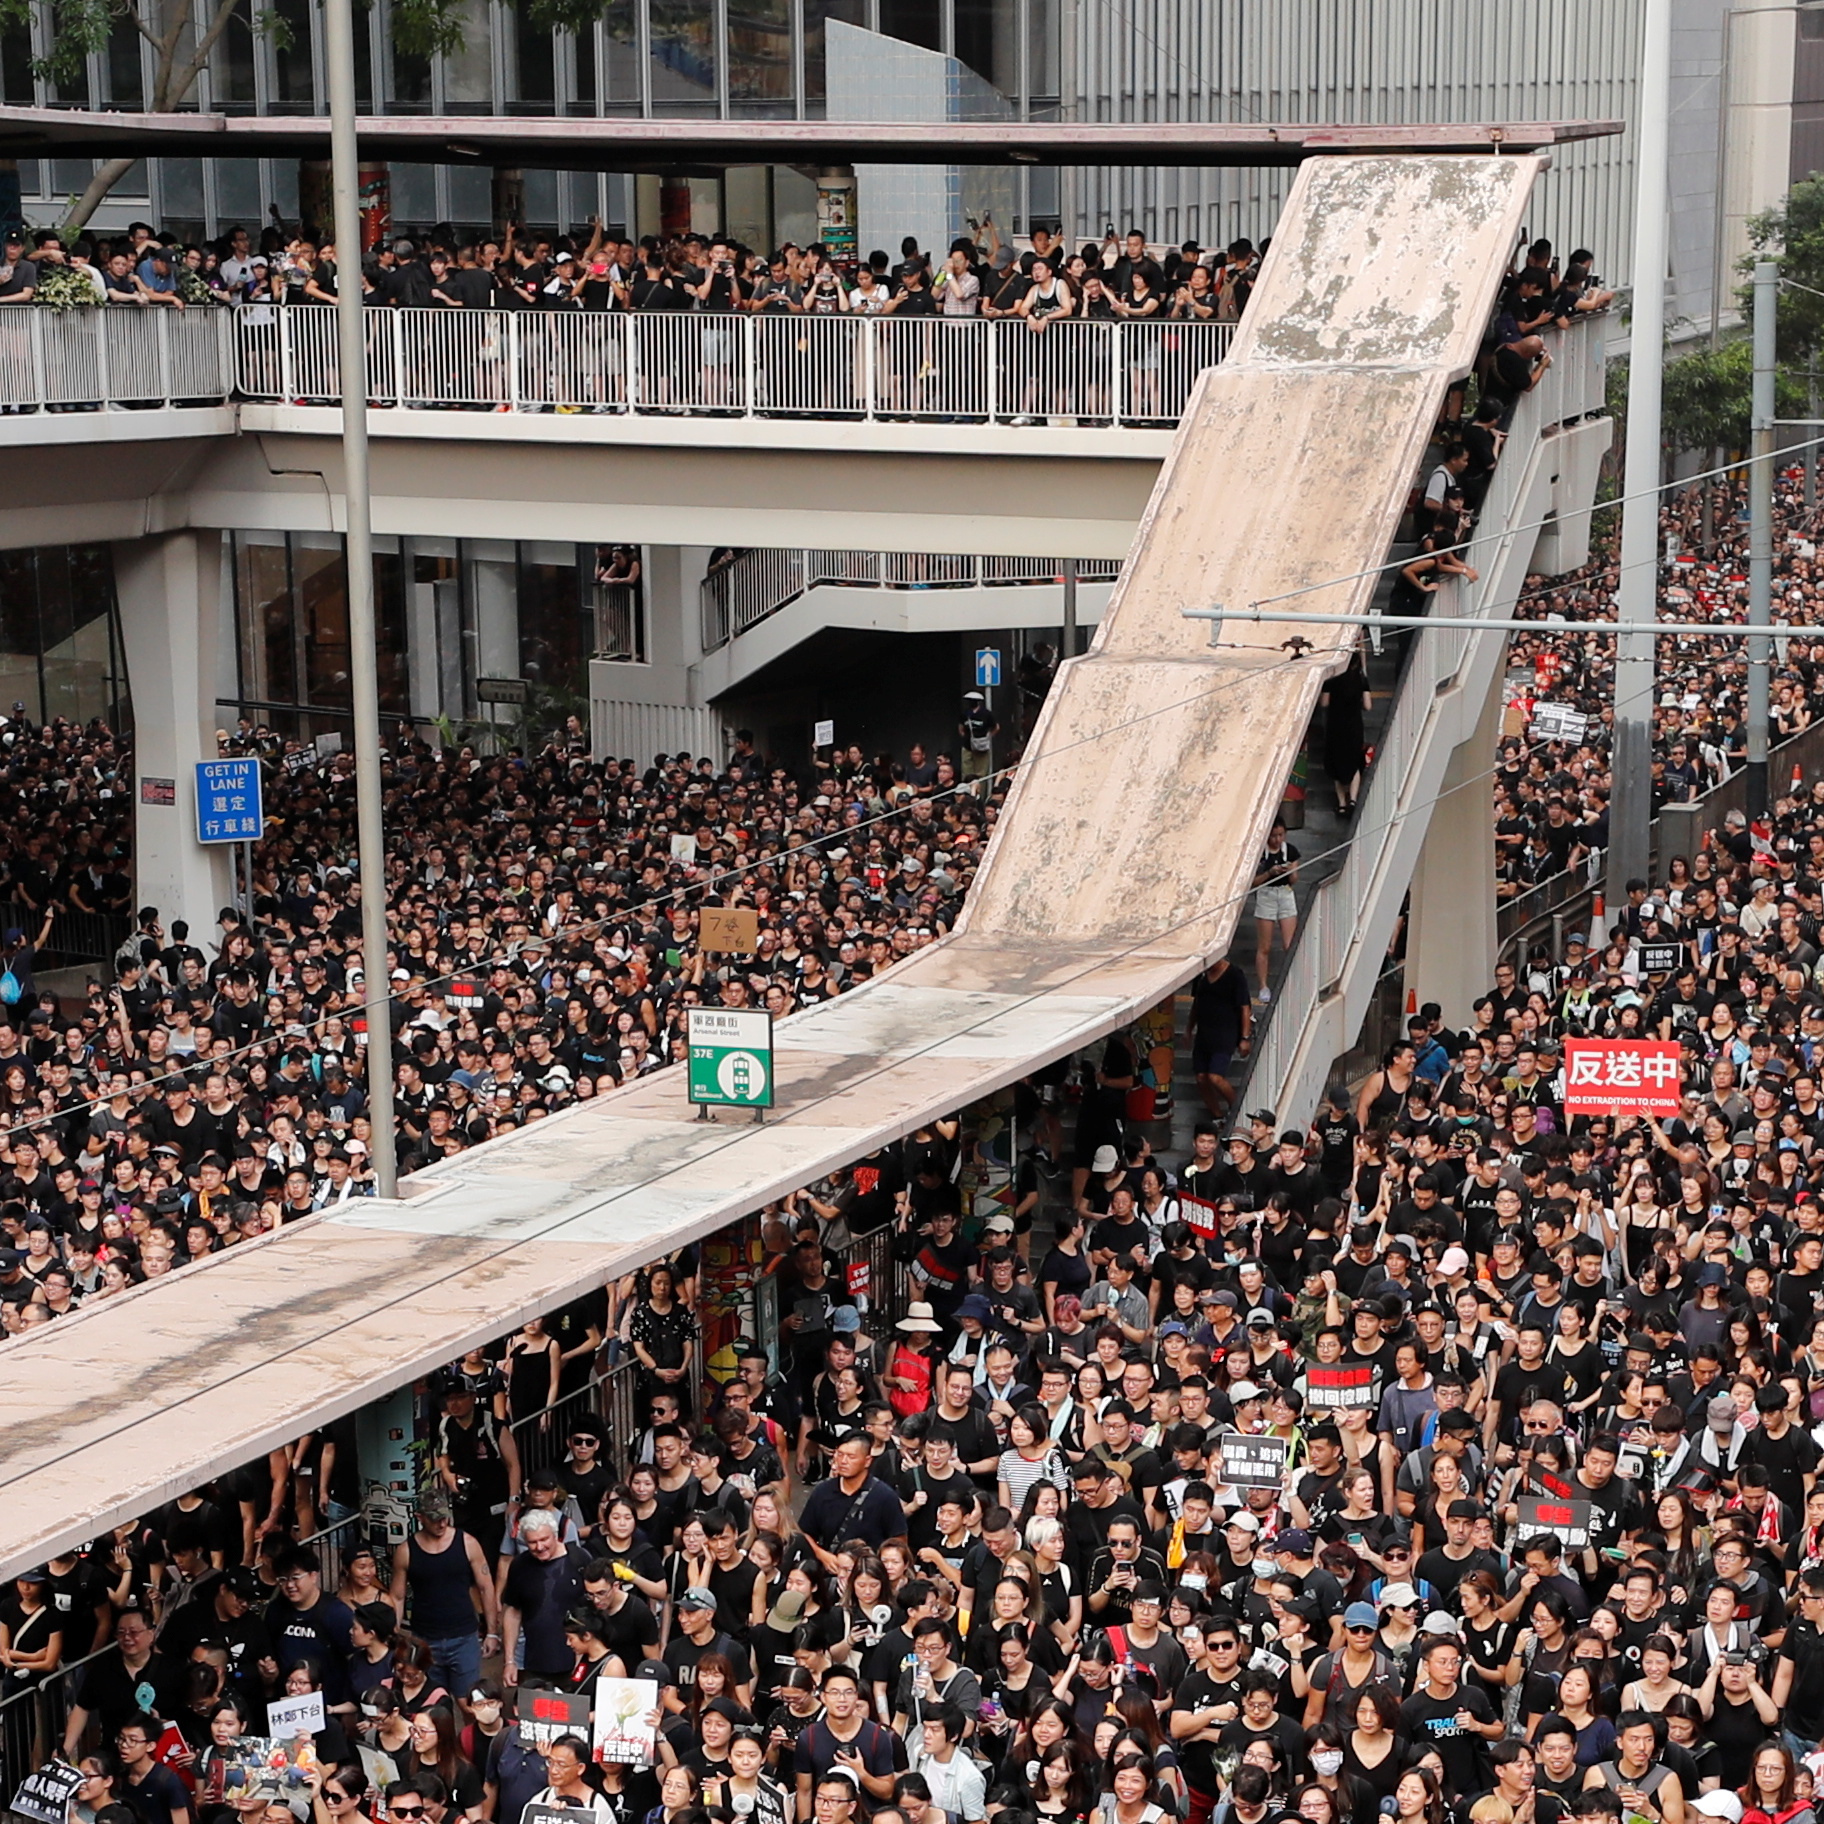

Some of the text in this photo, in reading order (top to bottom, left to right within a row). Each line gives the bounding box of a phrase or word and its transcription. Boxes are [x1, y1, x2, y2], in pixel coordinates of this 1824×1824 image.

[205, 763, 250, 777] GET IN
[210, 778, 245, 791] LANE
[212, 796, 246, 812] 選定
[693, 1027, 740, 1037] Arsenal Street
[694, 1049, 714, 1060] 37E
[1569, 1050, 1677, 1089] 反送中
[1568, 1096, 1676, 1107] NO EXTRADITION TO CHINA
[271, 1704, 320, 1726] 林鄭下台
[603, 1741, 643, 1756] 反送中
